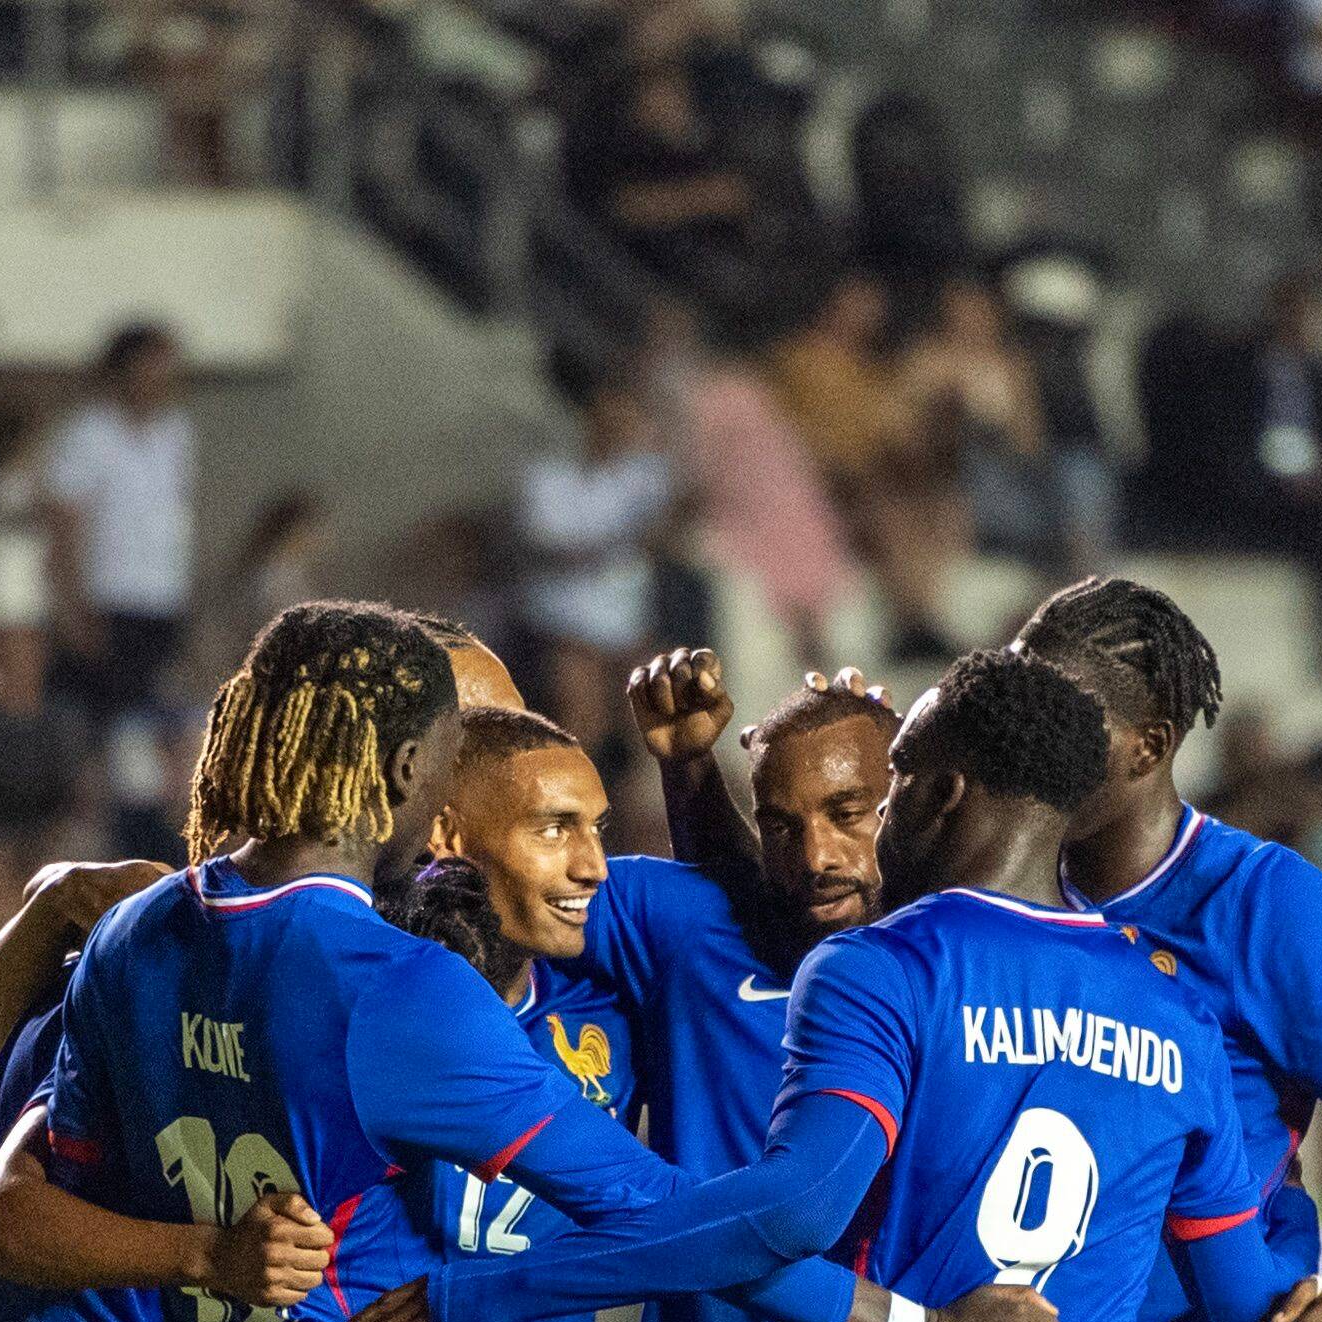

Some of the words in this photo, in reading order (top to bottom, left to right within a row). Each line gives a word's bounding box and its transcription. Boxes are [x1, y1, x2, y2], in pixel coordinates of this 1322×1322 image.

[963, 1005, 1183, 1094] KALIMUENDO
[454, 1164, 535, 1256] 12
[976, 1107, 1099, 1294] 9
